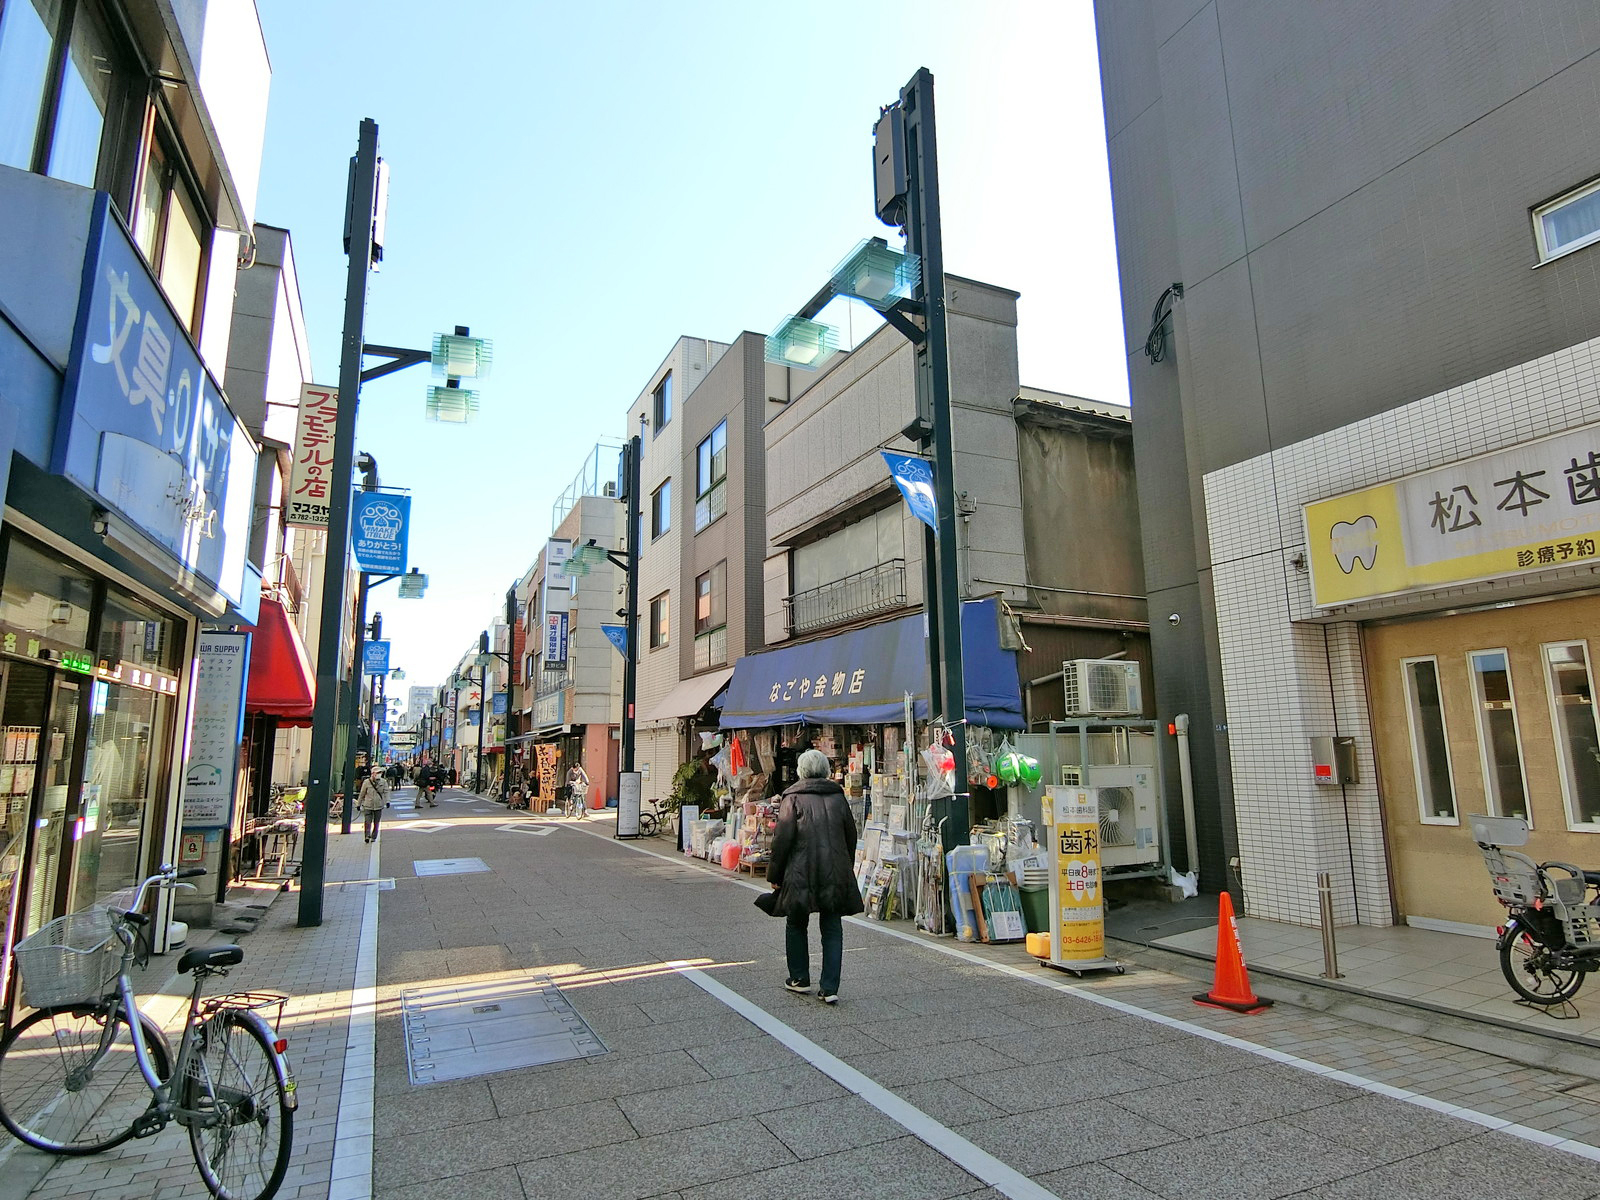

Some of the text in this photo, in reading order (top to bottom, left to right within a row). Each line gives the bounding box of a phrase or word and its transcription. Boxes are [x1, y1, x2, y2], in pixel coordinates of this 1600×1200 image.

[295, 390, 339, 499] プラモデルの店
[1516, 538, 1595, 568] 診療予約
[214, 645, 240, 654] SUPPLY
[769, 668, 866, 703] なごや金物店
[1060, 829, 1098, 855] 歯科
